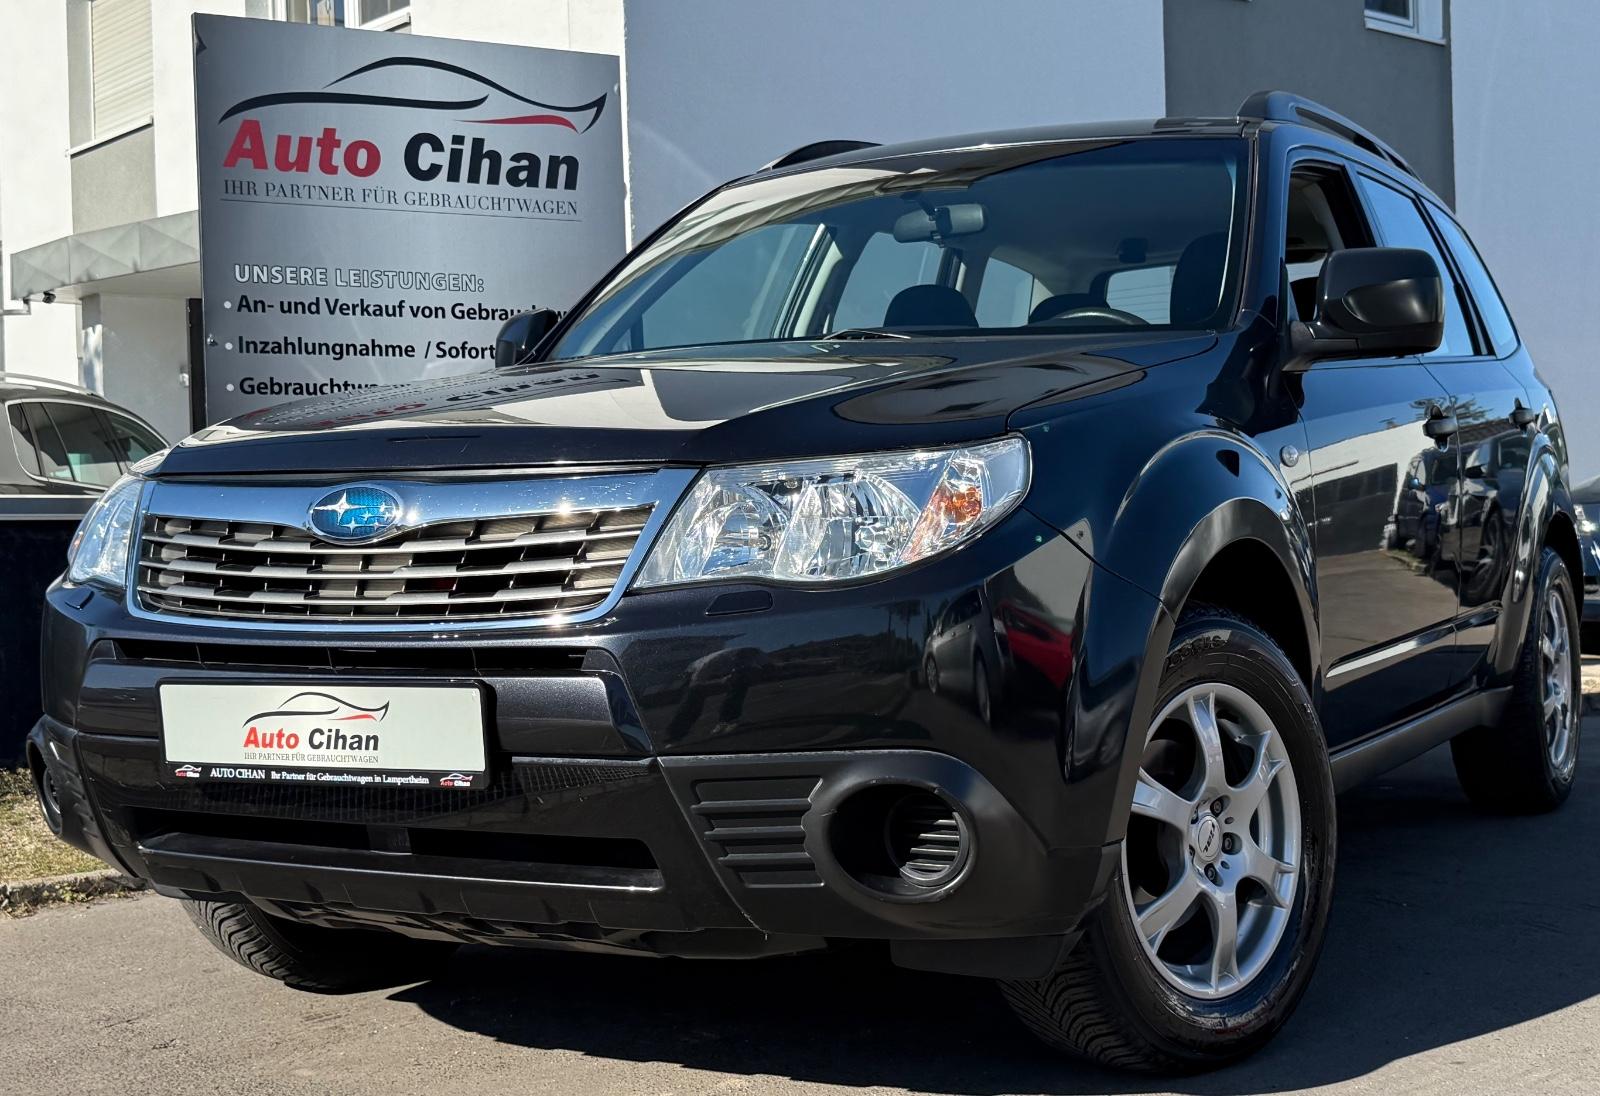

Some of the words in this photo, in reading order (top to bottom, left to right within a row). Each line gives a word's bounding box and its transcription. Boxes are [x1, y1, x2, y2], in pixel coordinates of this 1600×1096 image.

[223, 119, 381, 178] Auto
[403, 132, 580, 191] Cihan
[223, 179, 258, 198] IHR
[265, 182, 356, 203] PARTNER
[362, 184, 399, 205] FÜR
[404, 191, 578, 216] GEBRAUCHTWAGEN
[234, 264, 328, 286] UNSERE
[335, 268, 485, 293] LEISTUNGEN:
[236, 295, 274, 314] An-
[279, 296, 321, 316] und
[324, 297, 406, 318] Verkauf
[409, 304, 447, 320] von
[238, 336, 416, 362] Inzahlungnahme
[243, 726, 300, 749] Auto
[308, 727, 379, 751] Cihan
[244, 751, 257, 760] IHR
[258, 752, 290, 761] PARTNER
[291, 752, 305, 762] FÜR
[306, 754, 379, 764] GEBRAUCHTWAGEN
[210, 767, 235, 778] AUTO
[236, 768, 266, 780] CIHAN
[271, 772, 281, 780] Ihr
[281, 772, 305, 781] Partner
[317, 773, 373, 784] Gebrauchtwagen
[374, 774, 382, 783] in
[382, 775, 430, 786] Lampertheim
